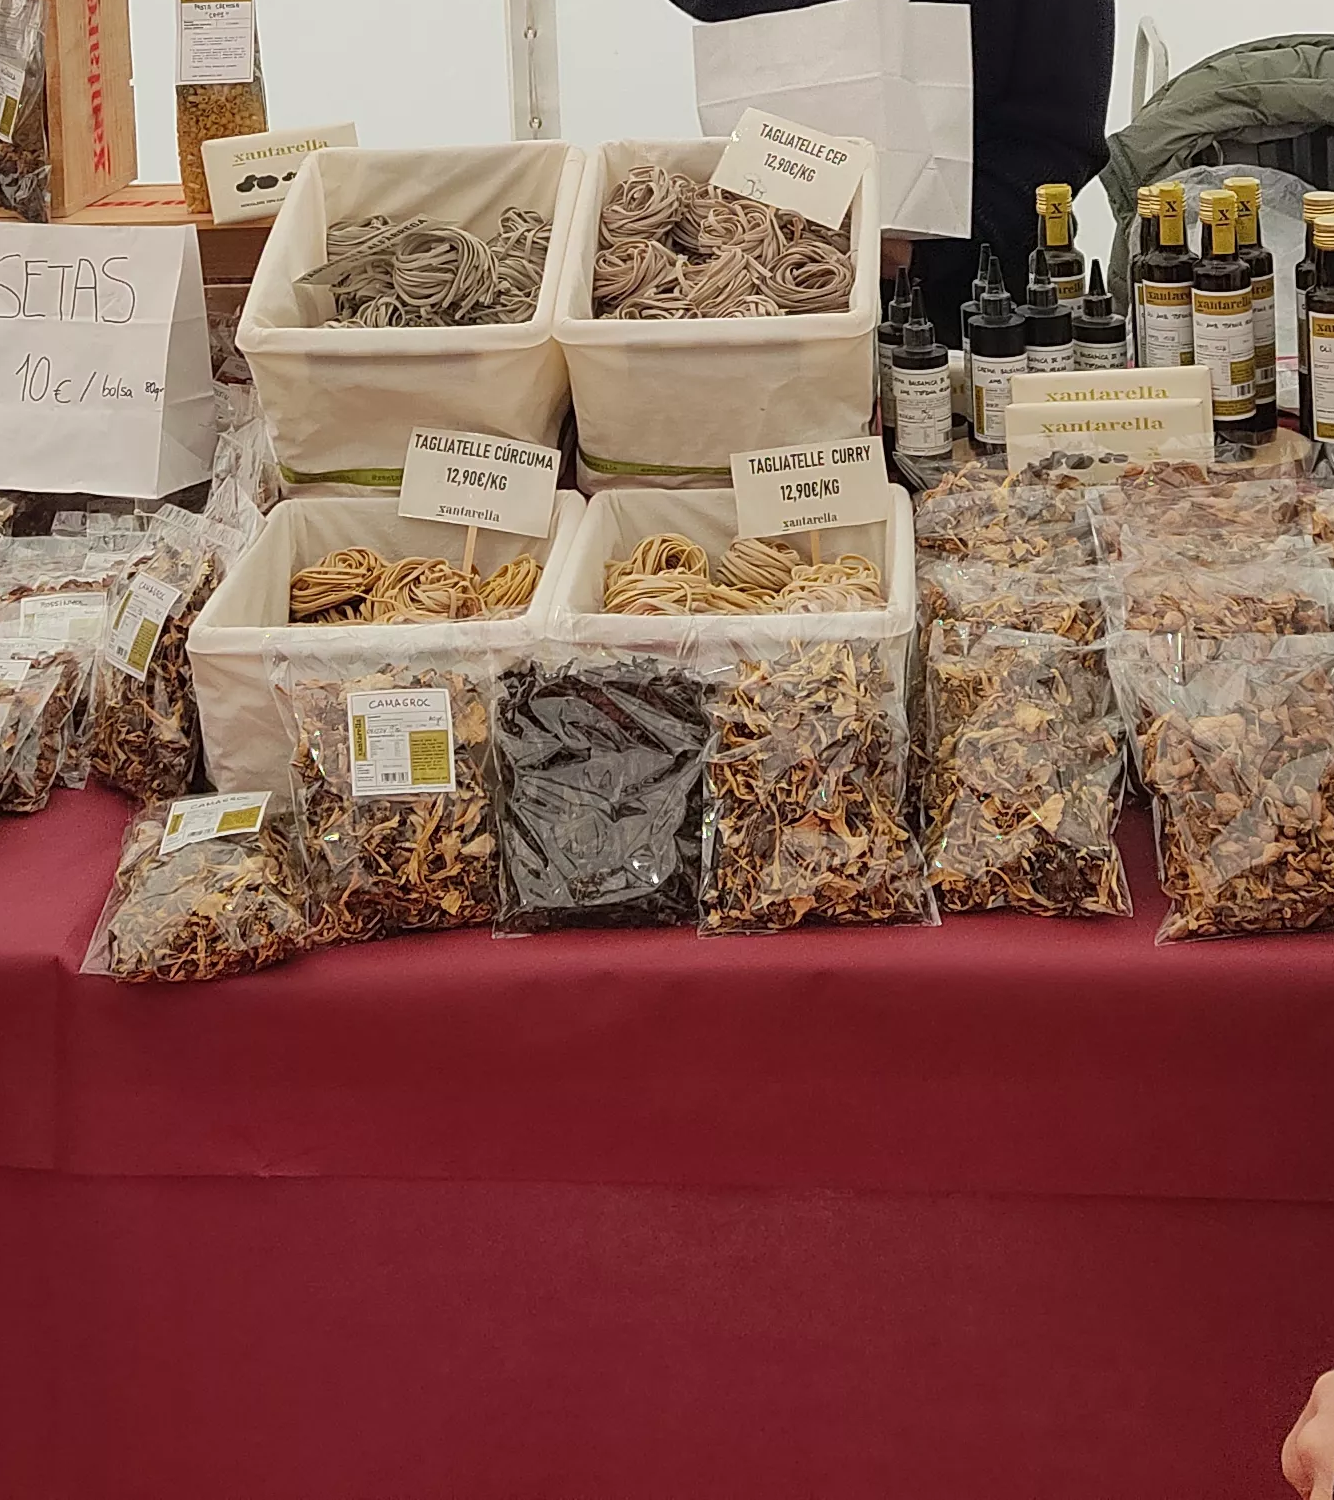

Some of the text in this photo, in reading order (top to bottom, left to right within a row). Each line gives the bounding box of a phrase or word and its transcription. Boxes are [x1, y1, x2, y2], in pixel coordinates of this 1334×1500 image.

[233, 138, 330, 164] xantarella
[759, 123, 848, 167] TAGLIATELLE CEP
[763, 152, 817, 183] 12,90€/KG
[1044, 385, 1169, 402] xantarella
[1039, 416, 1165, 434] xantarella
[414, 433, 554, 471] TAGLIATELLE CÚRCUMA
[748, 444, 871, 475] TAGLIATELLE CURRY
[446, 467, 508, 491] 12,90€/KG
[780, 478, 840, 503] 12,90€/KG
[437, 503, 500, 523] xantarella
[782, 512, 838, 529] xantarella
[368, 697, 431, 710] CAMAGROC
